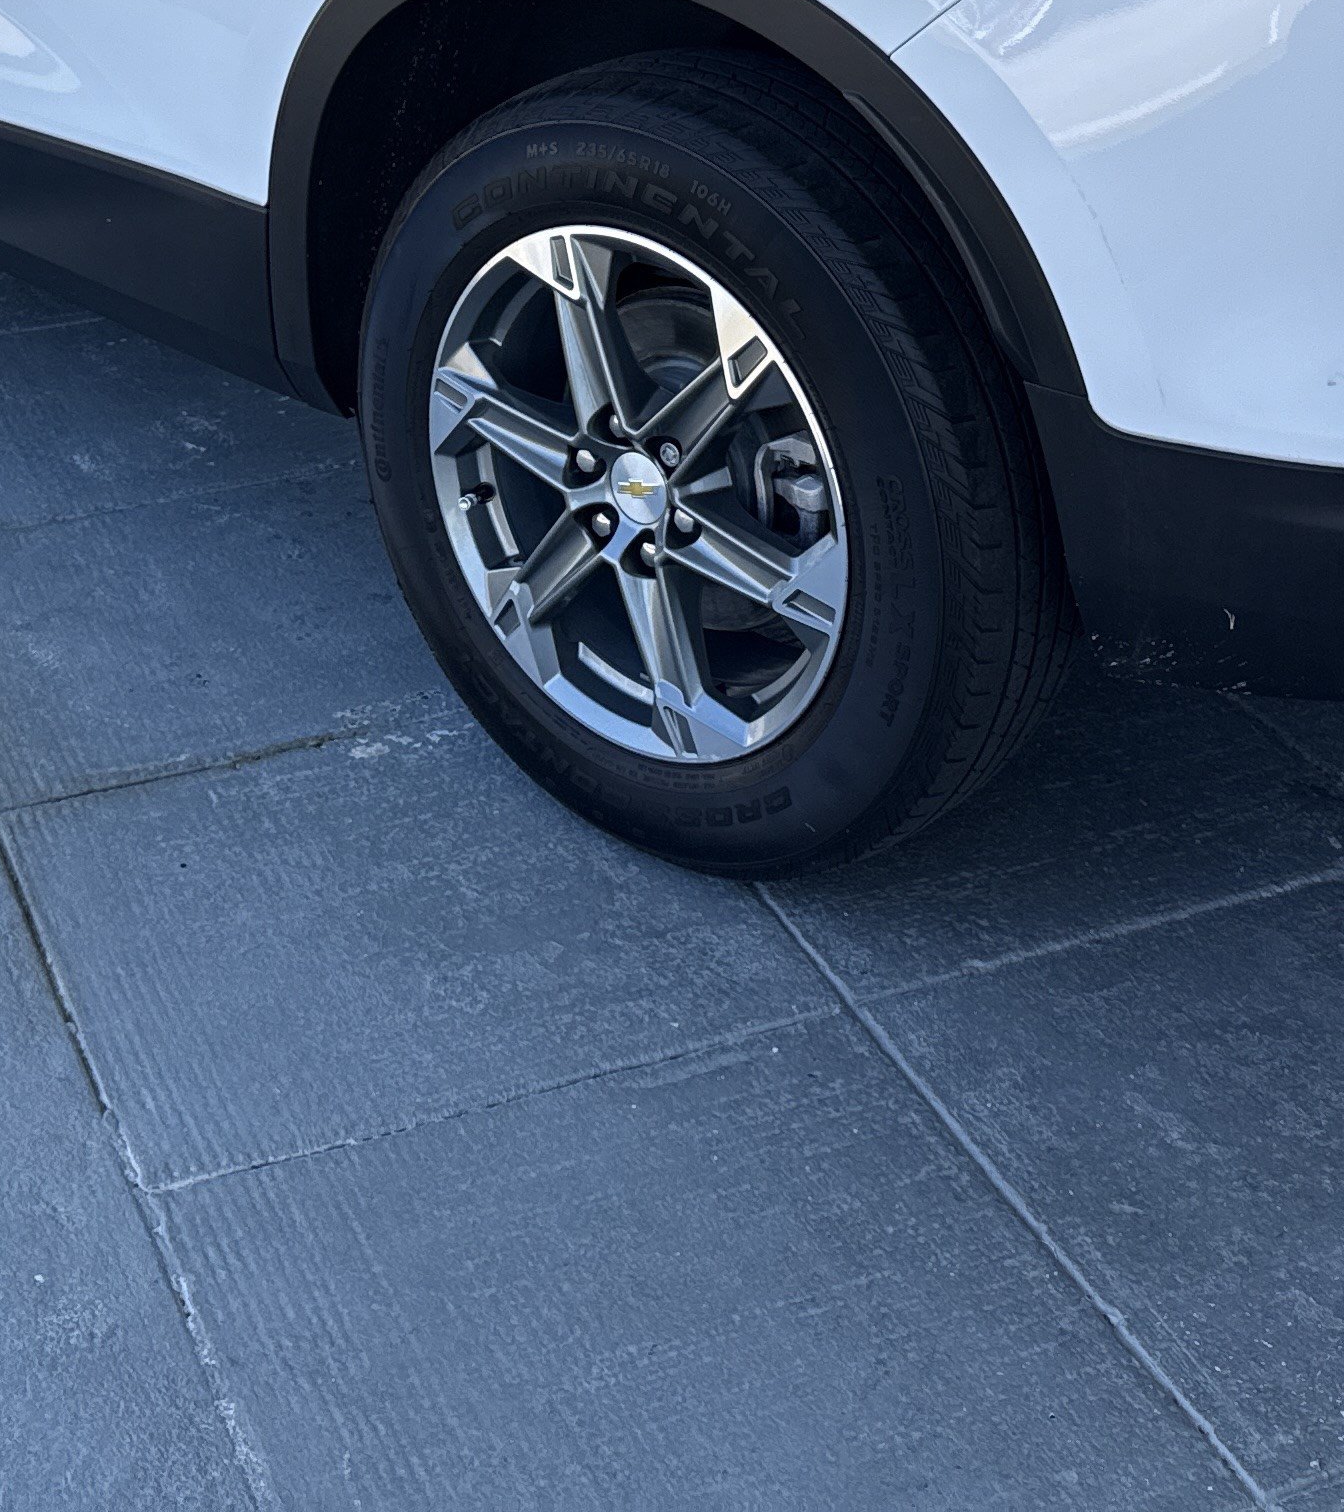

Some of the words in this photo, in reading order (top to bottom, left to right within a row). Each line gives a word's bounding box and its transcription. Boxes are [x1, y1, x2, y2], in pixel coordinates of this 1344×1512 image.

[525, 141, 560, 160] M+S
[575, 140, 673, 181] 235/65R18
[688, 178, 734, 217] 106H
[450, 164, 809, 341] CONTINENTAL
